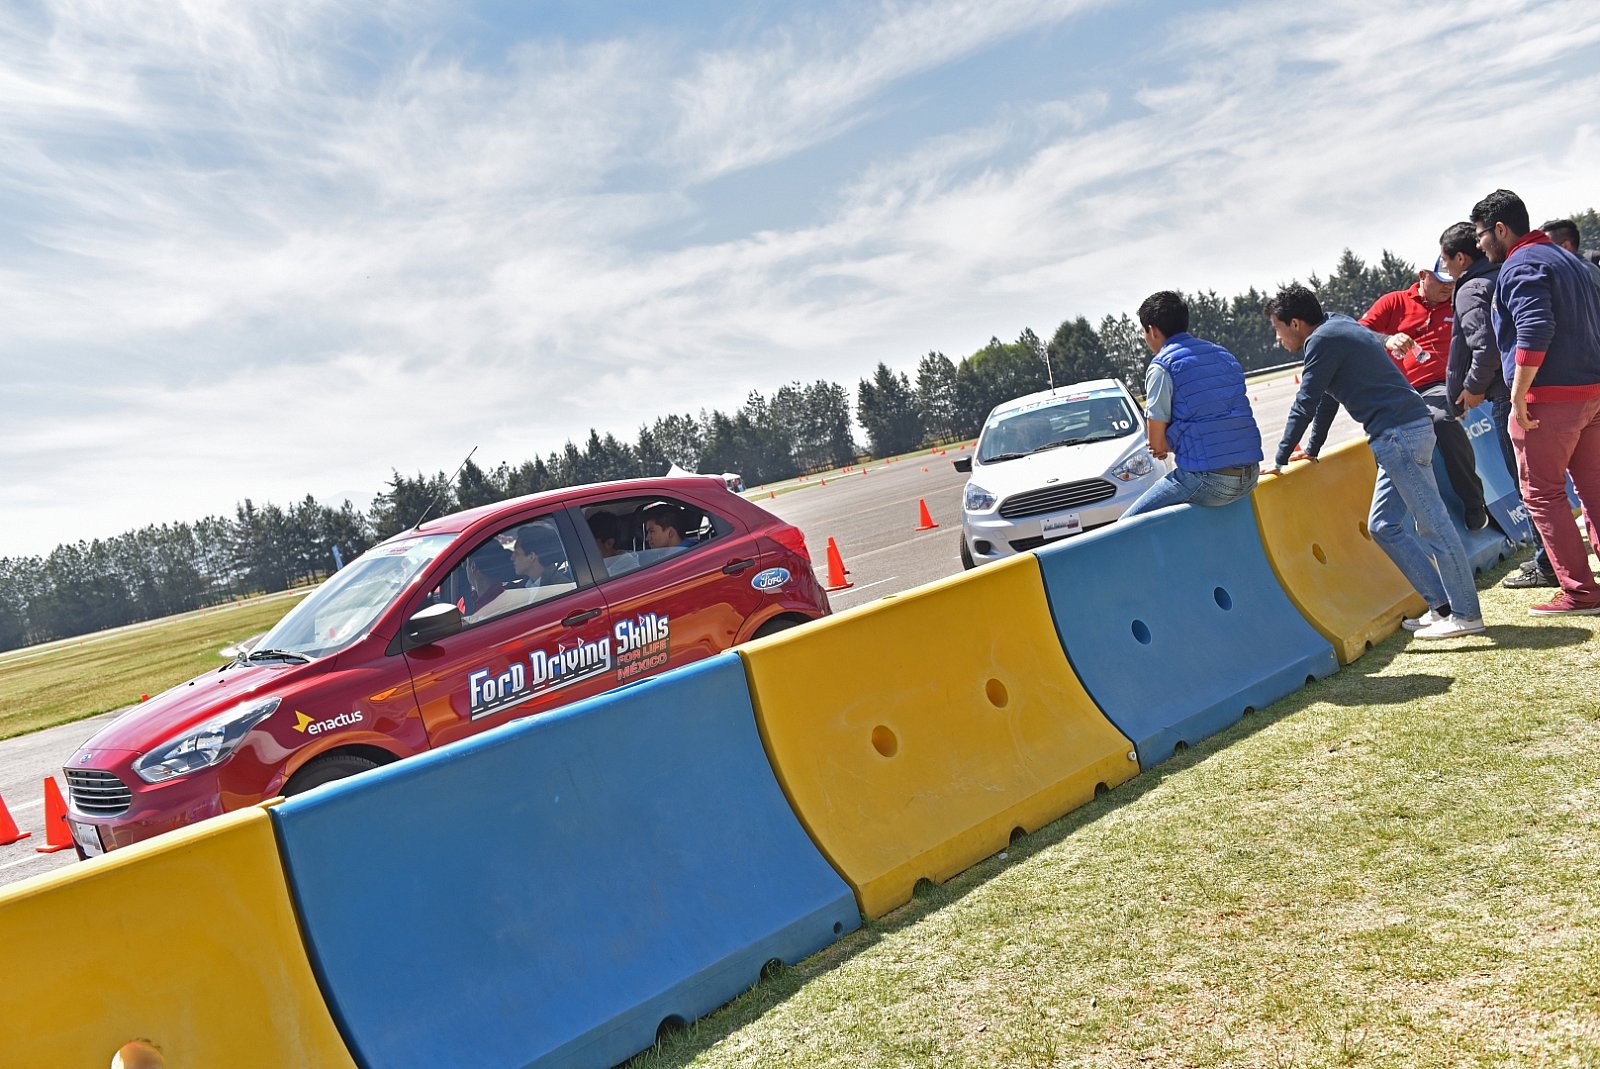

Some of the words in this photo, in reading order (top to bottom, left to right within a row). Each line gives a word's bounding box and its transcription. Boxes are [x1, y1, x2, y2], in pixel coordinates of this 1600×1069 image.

[1111, 419, 1130, 431] 10
[759, 570, 784, 588] Ford
[530, 637, 611, 686] Driving
[614, 613, 670, 655] Skills
[616, 648, 641, 667] FOR
[642, 639, 667, 657] LIFE
[616, 652, 668, 681] MÉXICO
[307, 710, 364, 735] enactus
